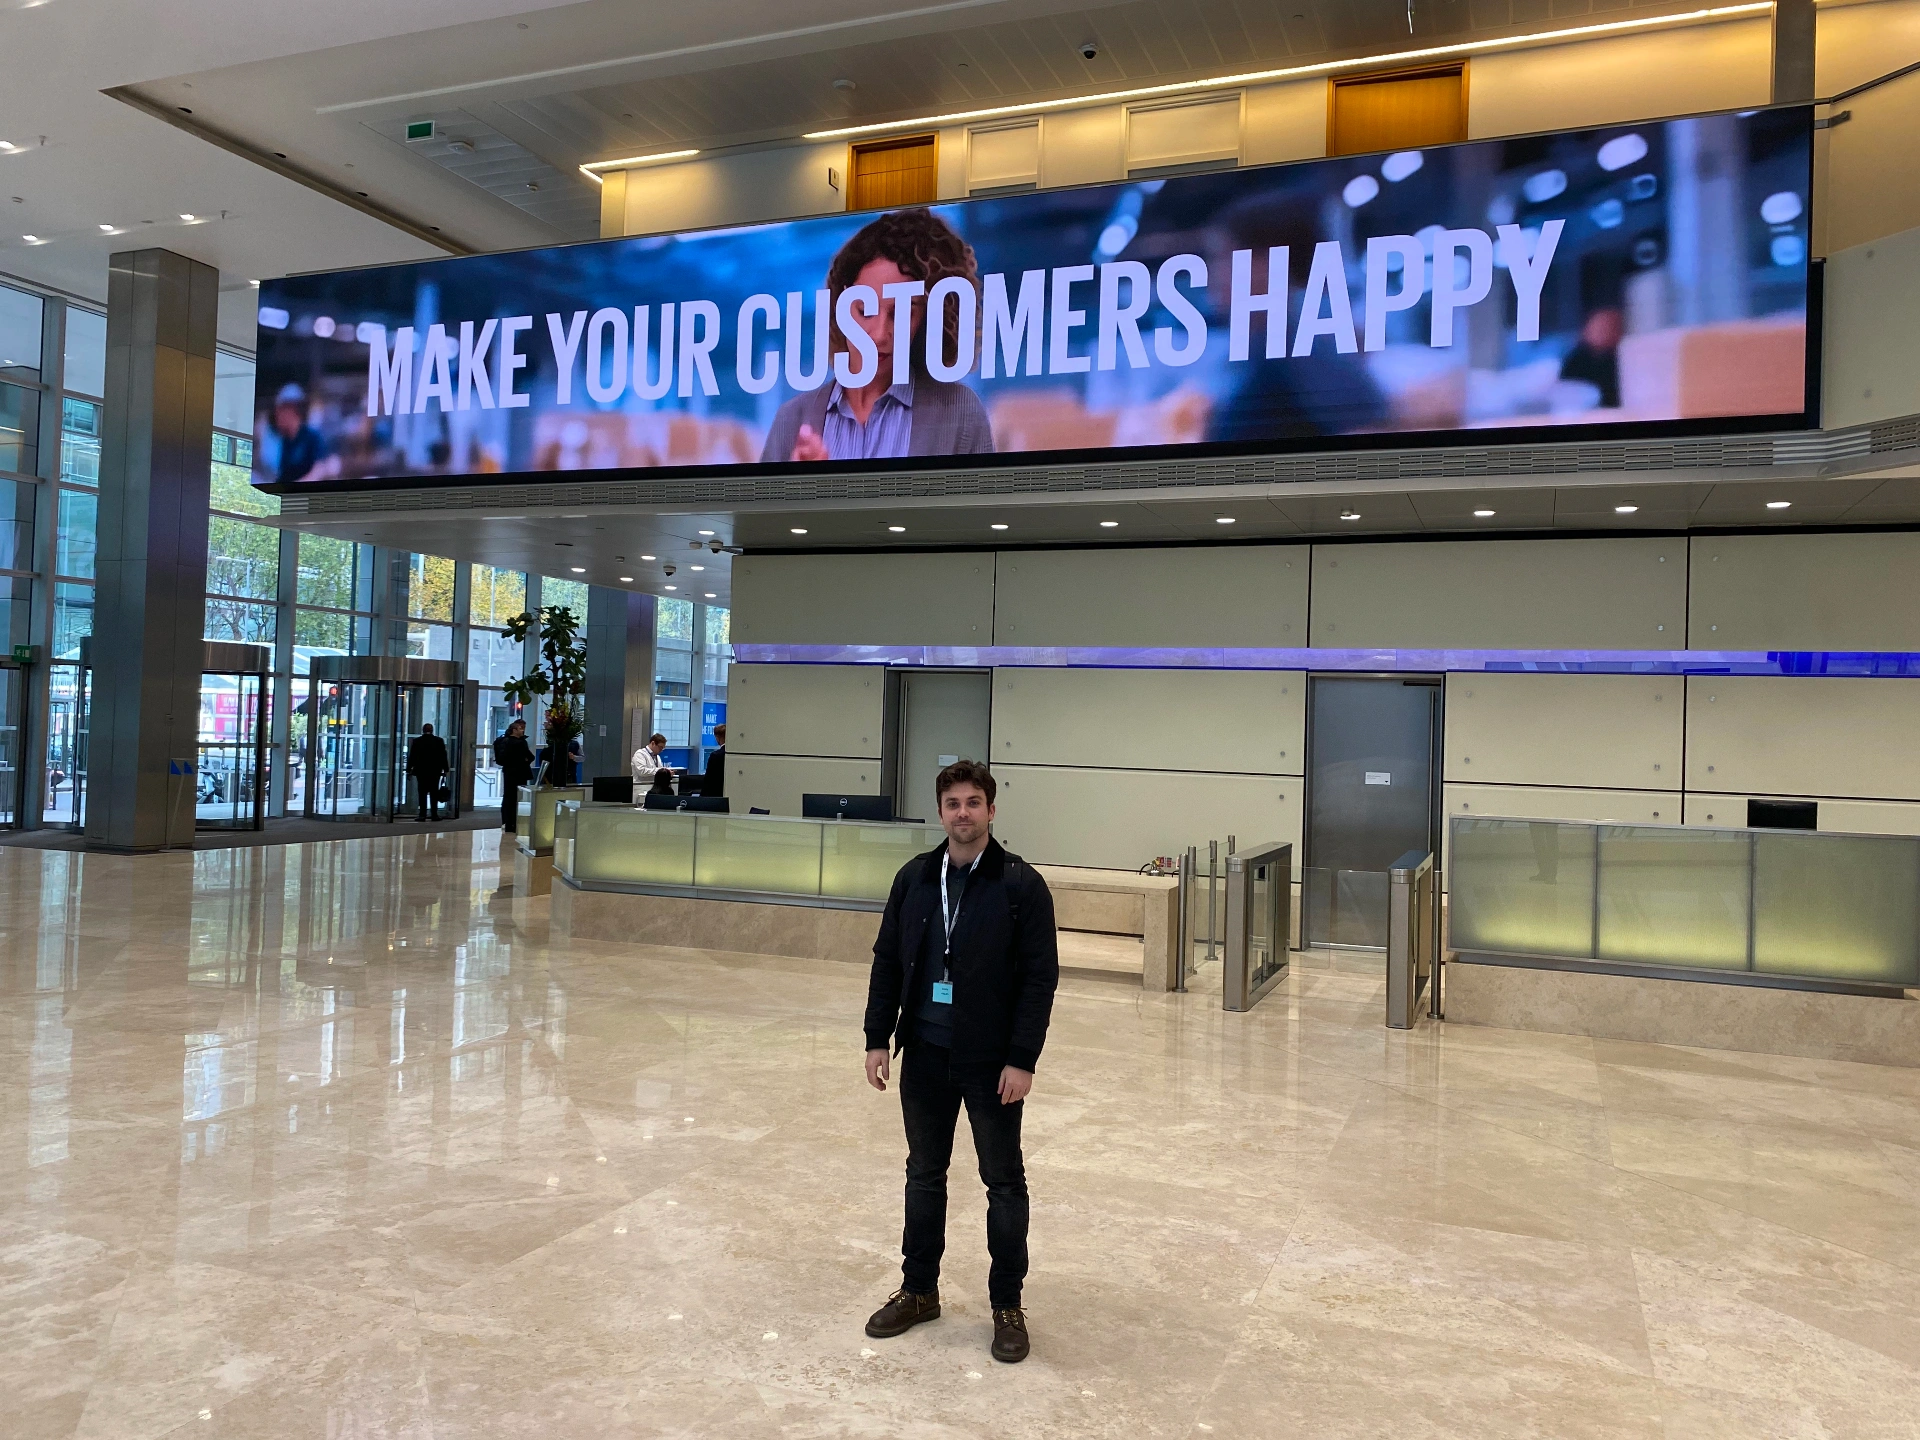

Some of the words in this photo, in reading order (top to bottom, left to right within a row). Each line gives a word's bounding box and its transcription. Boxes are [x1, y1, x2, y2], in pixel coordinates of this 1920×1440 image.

[367, 314, 532, 417] MAKE
[546, 299, 721, 404] YOUR
[736, 253, 1209, 396] CUSTOMERS
[1228, 218, 1566, 363] HAPPY
